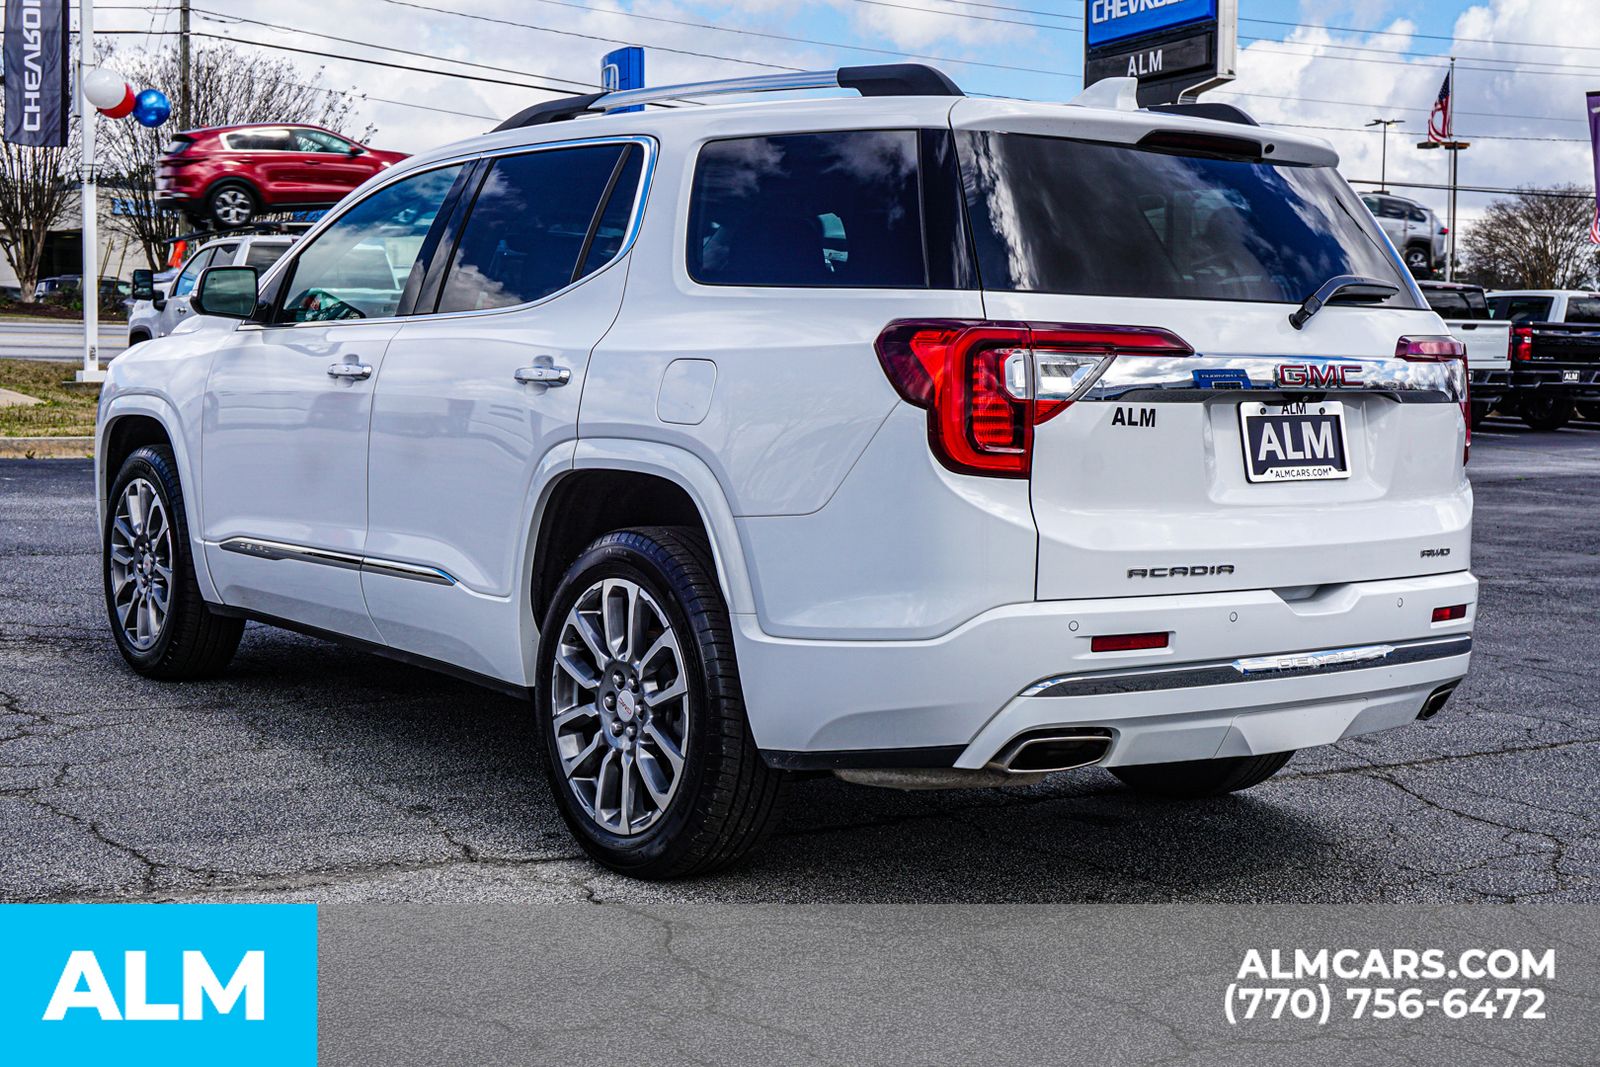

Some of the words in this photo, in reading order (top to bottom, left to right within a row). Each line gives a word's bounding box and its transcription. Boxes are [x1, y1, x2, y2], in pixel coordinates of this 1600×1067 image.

[1127, 49, 1163, 77] ALM
[1276, 364, 1364, 388] GMC
[1111, 406, 1157, 428] ALM
[1281, 403, 1307, 415] ALM
[1257, 421, 1335, 461] ALM
[1274, 468, 1330, 479] ALMCARS.COM
[1420, 548, 1451, 558] AWD
[1127, 565, 1235, 579] ACADIA
